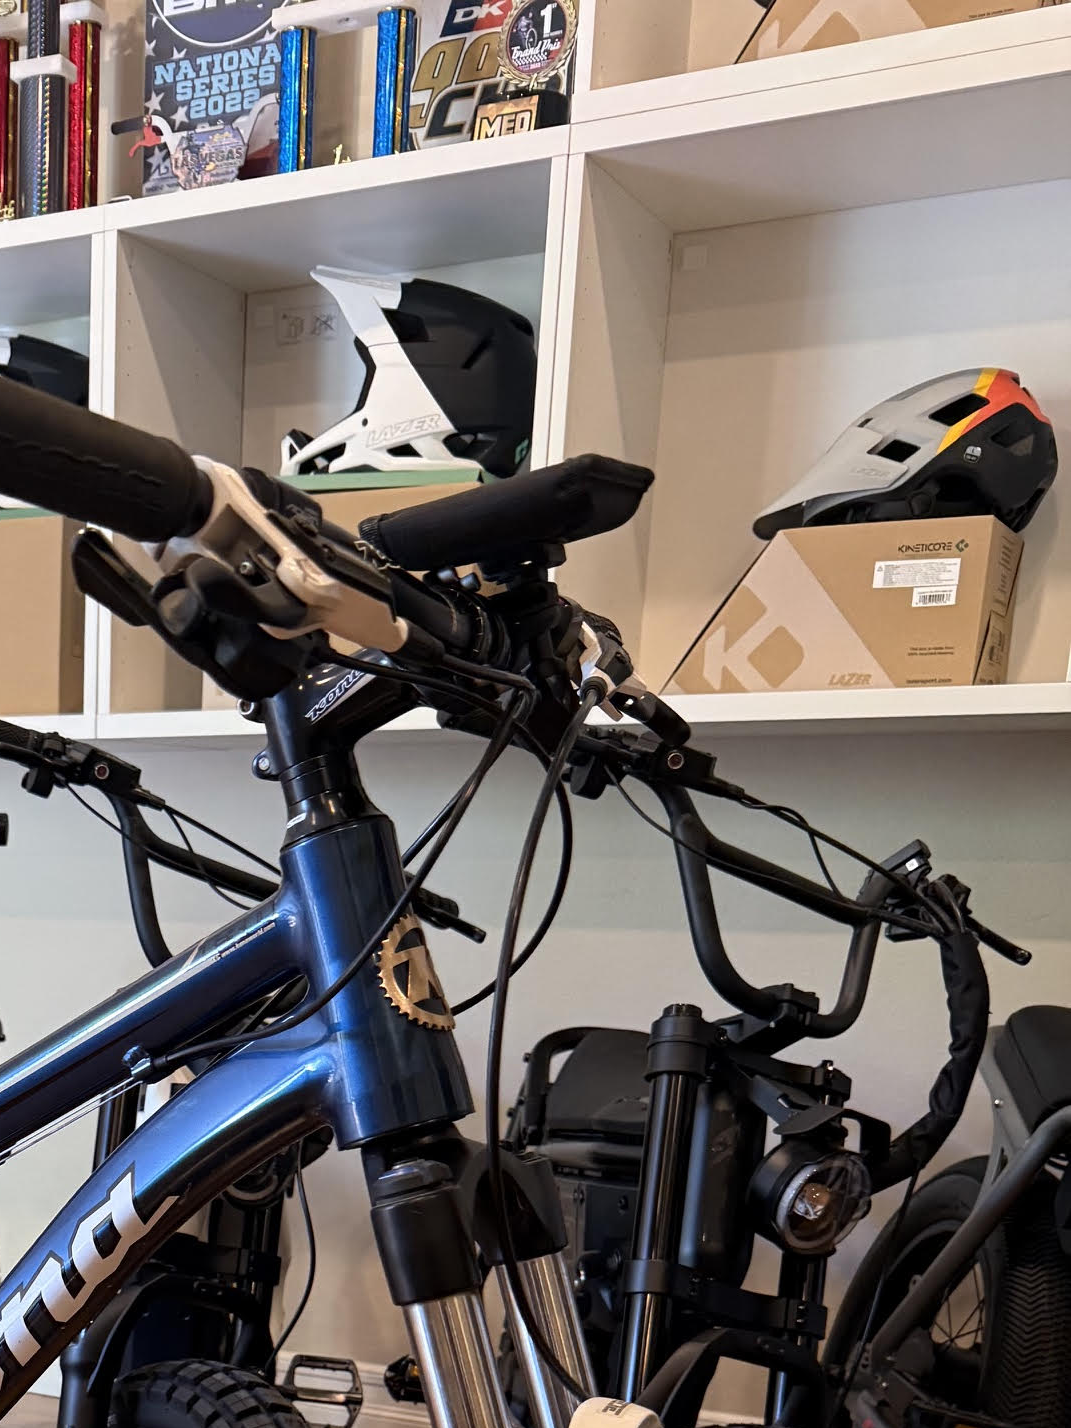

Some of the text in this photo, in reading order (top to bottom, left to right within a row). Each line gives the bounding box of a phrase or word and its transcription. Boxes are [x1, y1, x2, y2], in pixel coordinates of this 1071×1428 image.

[154, 43, 281, 86] NATIONA
[511, 41, 542, 59] Grand
[175, 64, 276, 102] SERIES
[189, 88, 260, 119] 2022
[365, 413, 442, 447] LAZER
[829, 673, 873, 687] LAZER
